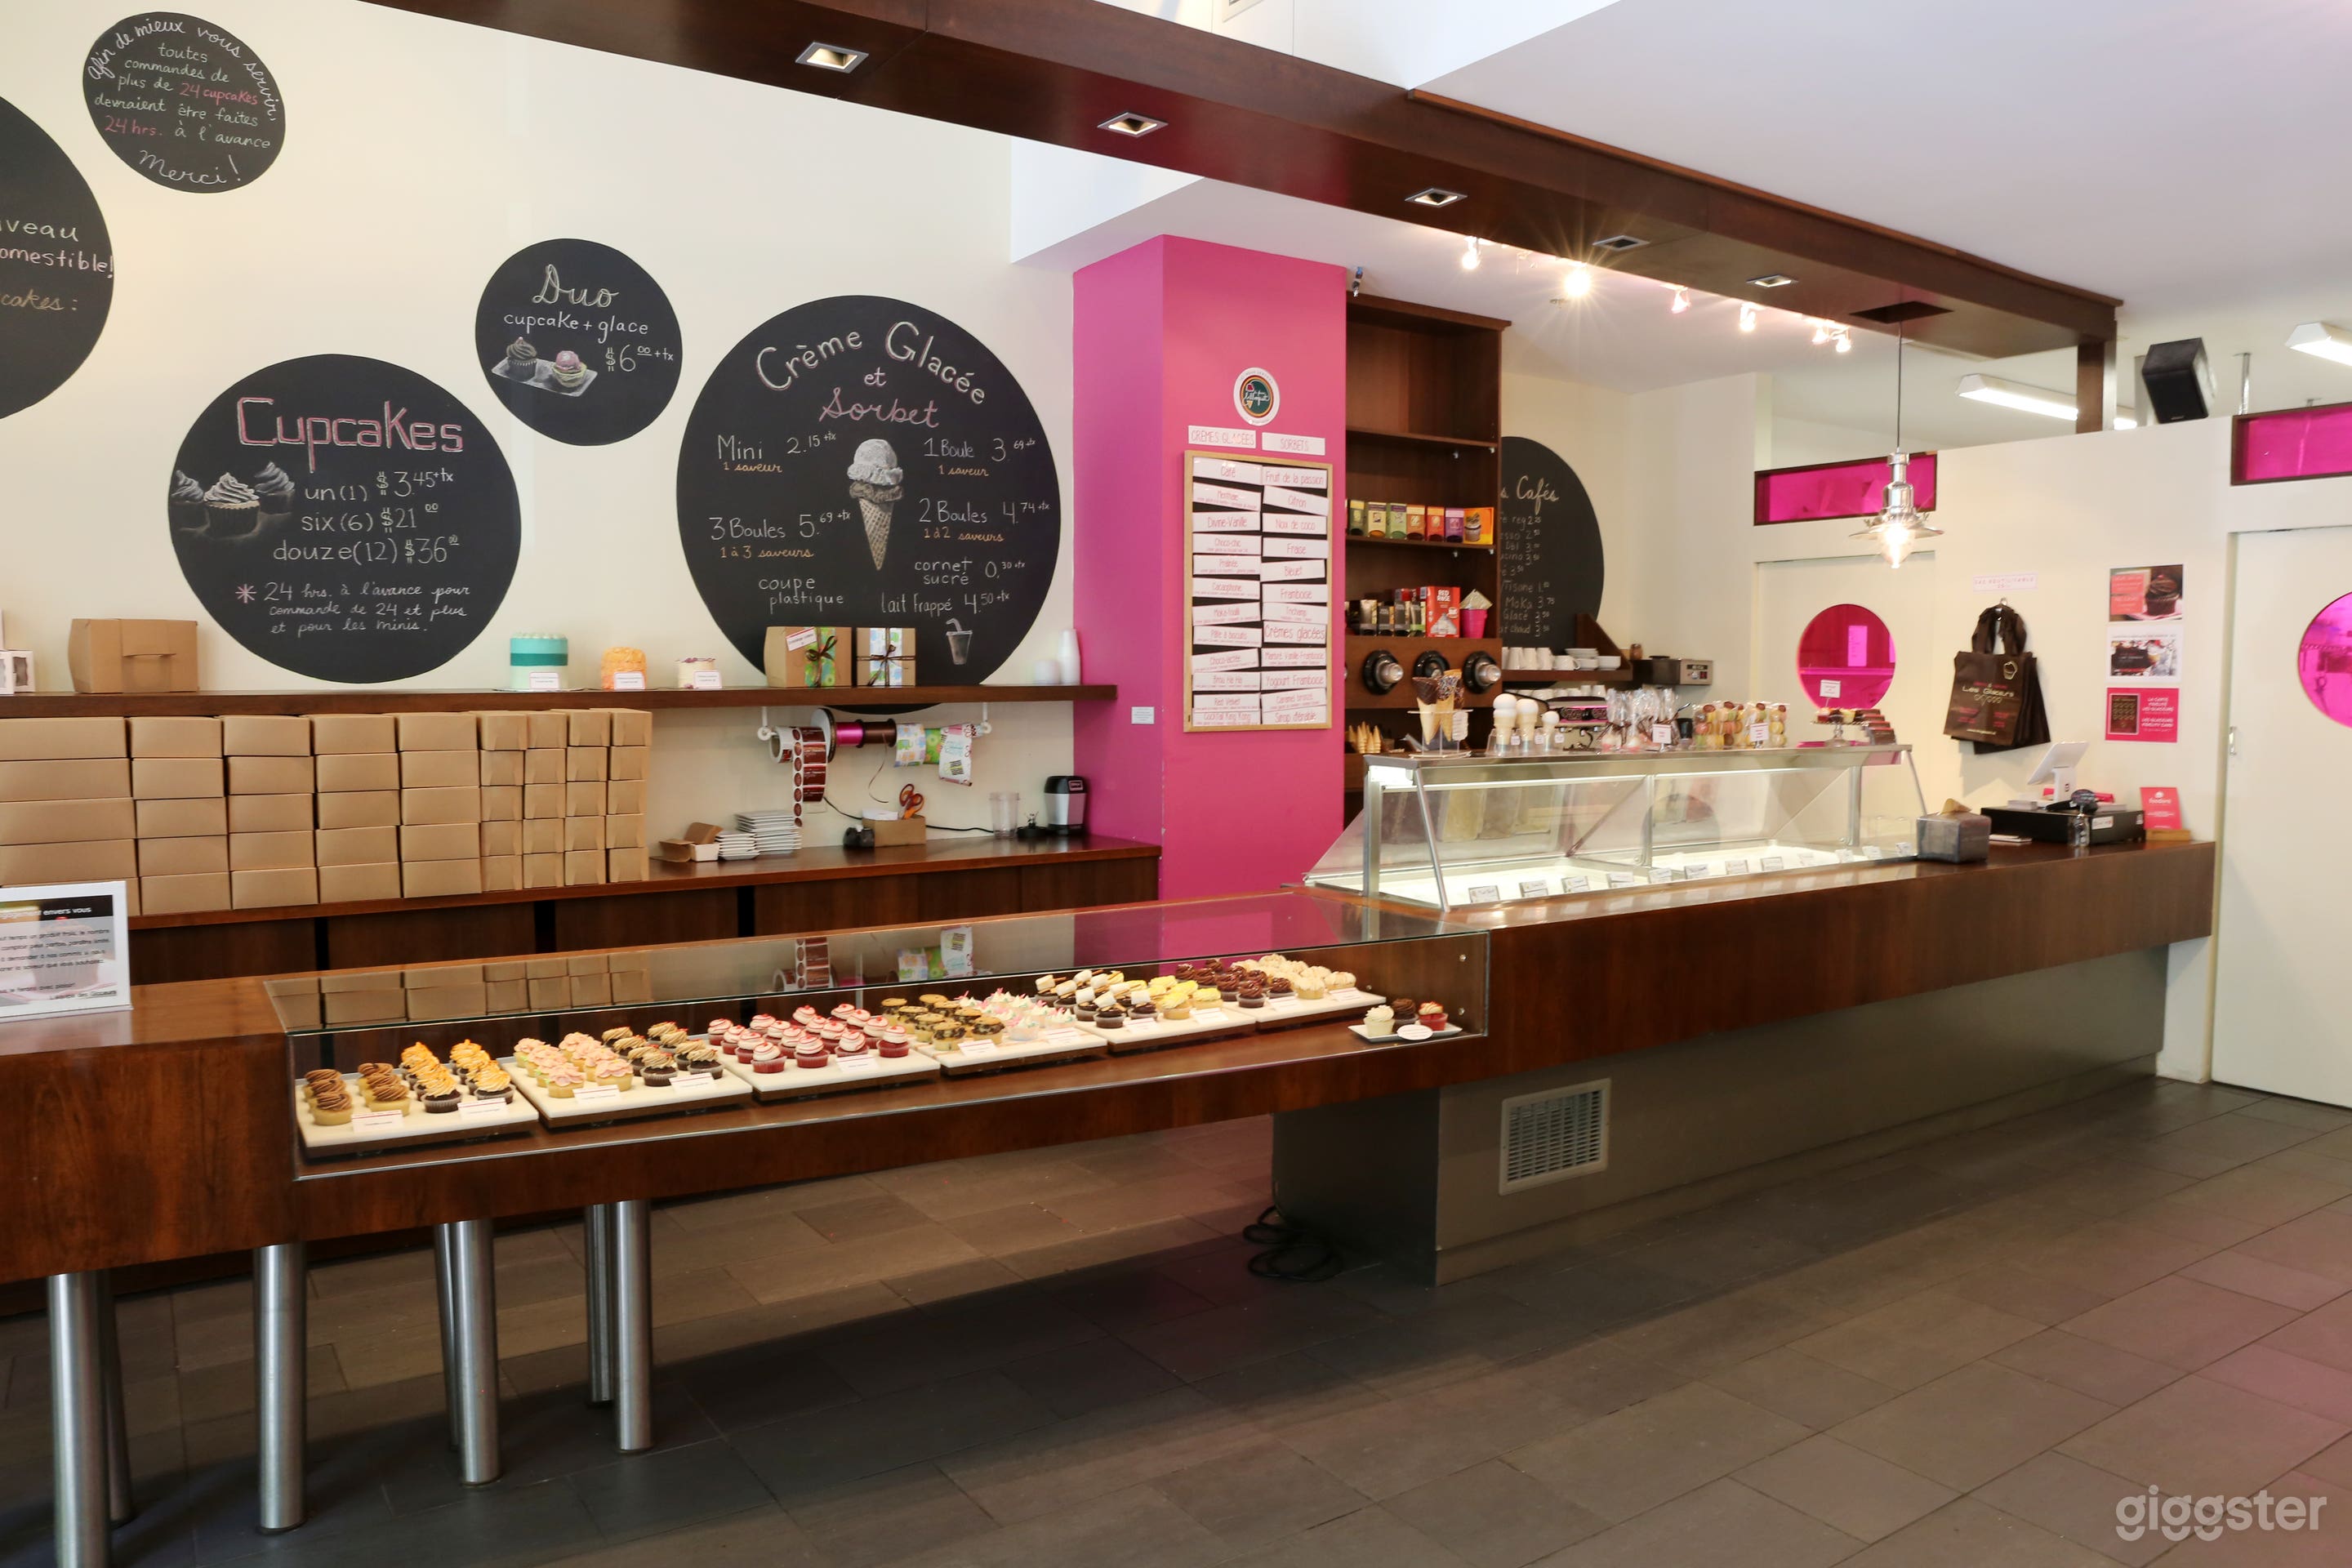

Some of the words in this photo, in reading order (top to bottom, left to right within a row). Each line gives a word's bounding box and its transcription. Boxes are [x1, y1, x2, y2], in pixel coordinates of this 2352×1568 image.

[116, 33, 134, 49] de
[135, 18, 186, 38] mieux
[197, 26, 241, 59] vous
[158, 42, 208, 63] toutes
[124, 59, 206, 79] commandes
[211, 67, 229, 82] de
[117, 73, 147, 91] plus
[154, 77, 173, 91] de
[179, 82, 200, 99] 24
[94, 92, 167, 112] devraient
[178, 103, 207, 119] être
[216, 107, 258, 127] faites
[104, 115, 127, 134] 24
[175, 120, 187, 138] à
[0, 220, 78, 242] veau
[532, 264, 620, 308] Duo
[755, 331, 863, 390] Crème
[885, 320, 986, 404] Glacée
[863, 367, 886, 387] et
[818, 386, 940, 428] Sorbet
[717, 434, 764, 460] Mini
[923, 437, 940, 457] 1
[941, 439, 975, 458] Boule
[1280, 439, 1309, 452] SORBETS
[723, 461, 729, 472] 1
[734, 462, 783, 474] saveur
[939, 464, 945, 475] 1
[948, 466, 990, 478] saveur
[1265, 470, 1280, 483] Fruit
[1282, 473, 1290, 483] de
[1293, 473, 1298, 483] la
[1301, 475, 1324, 486] passion
[1288, 495, 1307, 506] Citron
[1517, 474, 1560, 515] Cafés
[919, 498, 932, 522] 2
[937, 501, 988, 523] Boules
[709, 517, 727, 541] 3
[728, 517, 786, 540] Boules
[924, 528, 930, 539] 1
[958, 531, 1005, 542] saveurs
[720, 547, 726, 559] 1
[730, 546, 739, 559] à
[742, 546, 752, 559] 3
[758, 546, 814, 559] saveurs
[914, 559, 973, 572] cornet
[759, 577, 817, 599] coupe
[923, 572, 970, 586] sucré
[264, 581, 293, 602] 24
[341, 584, 351, 595] à
[361, 581, 422, 596] l'avance
[431, 586, 471, 604] pour
[769, 592, 844, 614] plastique
[270, 604, 341, 616] commande
[350, 603, 367, 615] de
[376, 603, 398, 617] 24
[404, 603, 422, 617] et
[430, 604, 468, 621] plus
[881, 593, 906, 614] lait
[913, 592, 952, 617] frappé
[271, 621, 287, 635] et
[298, 621, 332, 638] pour
[343, 619, 367, 631] les
